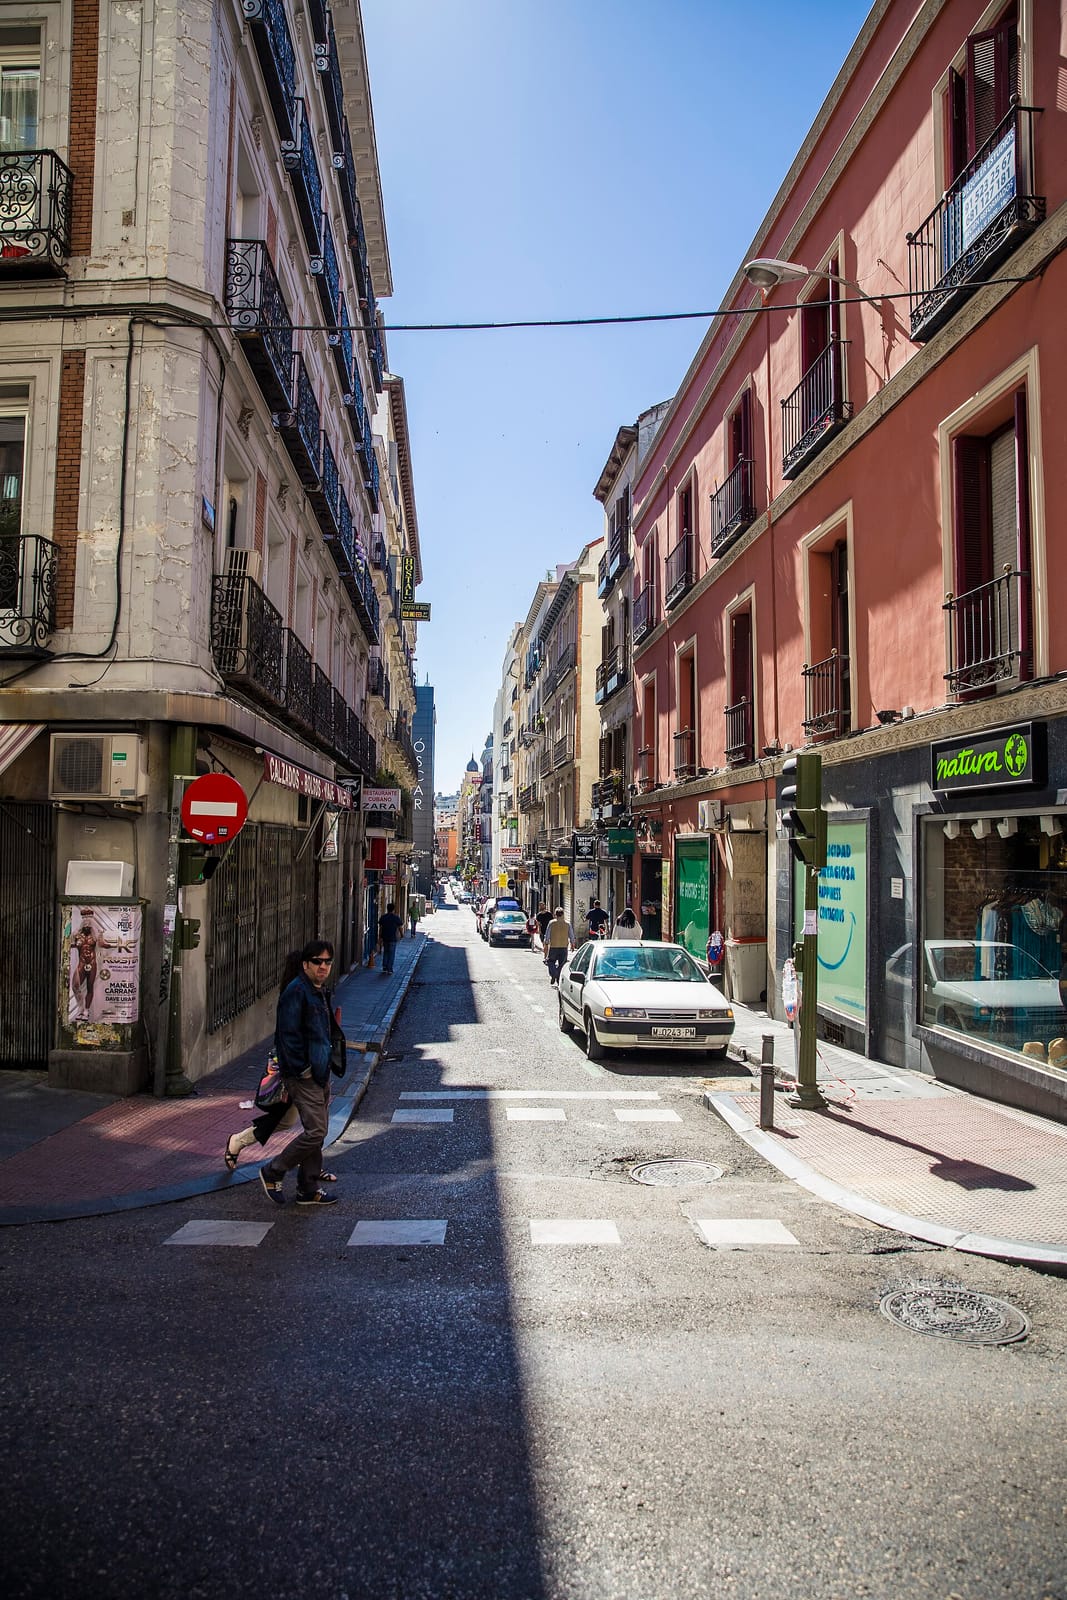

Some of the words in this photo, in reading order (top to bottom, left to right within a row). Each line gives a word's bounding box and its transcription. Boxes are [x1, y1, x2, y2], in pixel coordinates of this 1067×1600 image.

[976, 180, 989, 202] 523
[990, 167, 999, 183] 25
[1002, 150, 1012, 170] 67
[981, 188, 994, 210] 127
[997, 168, 1010, 188] 181
[405, 558, 413, 596] HOSTAL
[269, 757, 300, 790] CALZADOS
[936, 749, 1003, 781] natura
[118, 921, 132, 929] PRIDE
